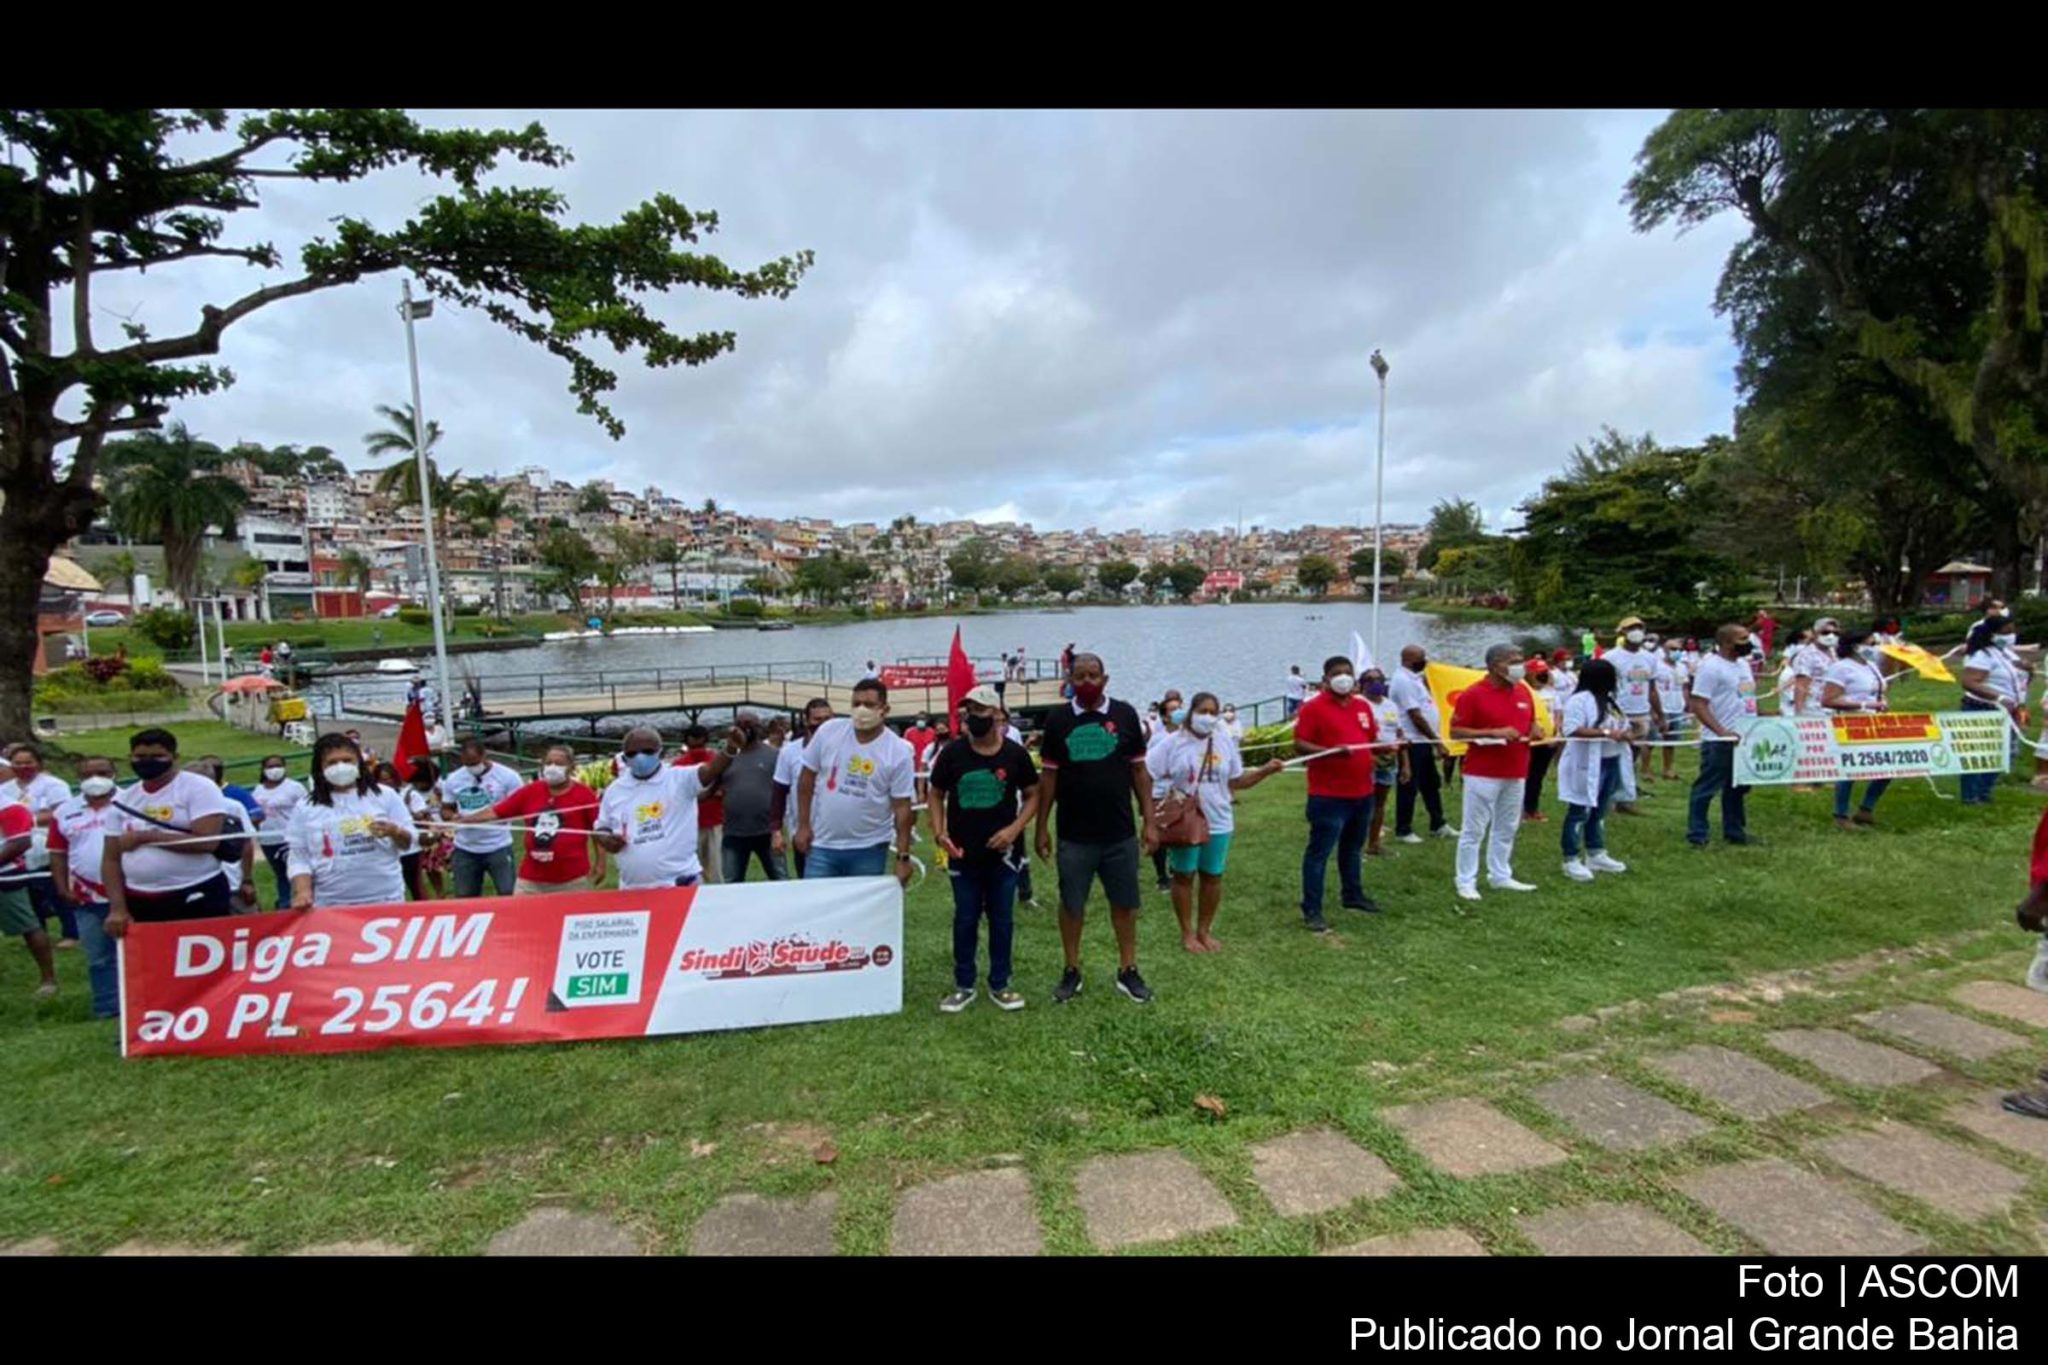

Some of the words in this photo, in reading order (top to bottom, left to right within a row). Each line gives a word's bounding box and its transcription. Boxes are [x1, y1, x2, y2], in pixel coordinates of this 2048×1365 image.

[1841, 752, 1857, 766] PL
[1858, 750, 1929, 766] 2564/2020
[174, 928, 332, 983] Diga
[351, 912, 495, 965] SIM
[679, 946, 745, 971] Sindi
[576, 950, 625, 969] VOTE
[577, 976, 618, 995] SIM
[137, 1006, 209, 1042] ao
[226, 992, 301, 1040] PL
[319, 977, 530, 1037] 2564!
